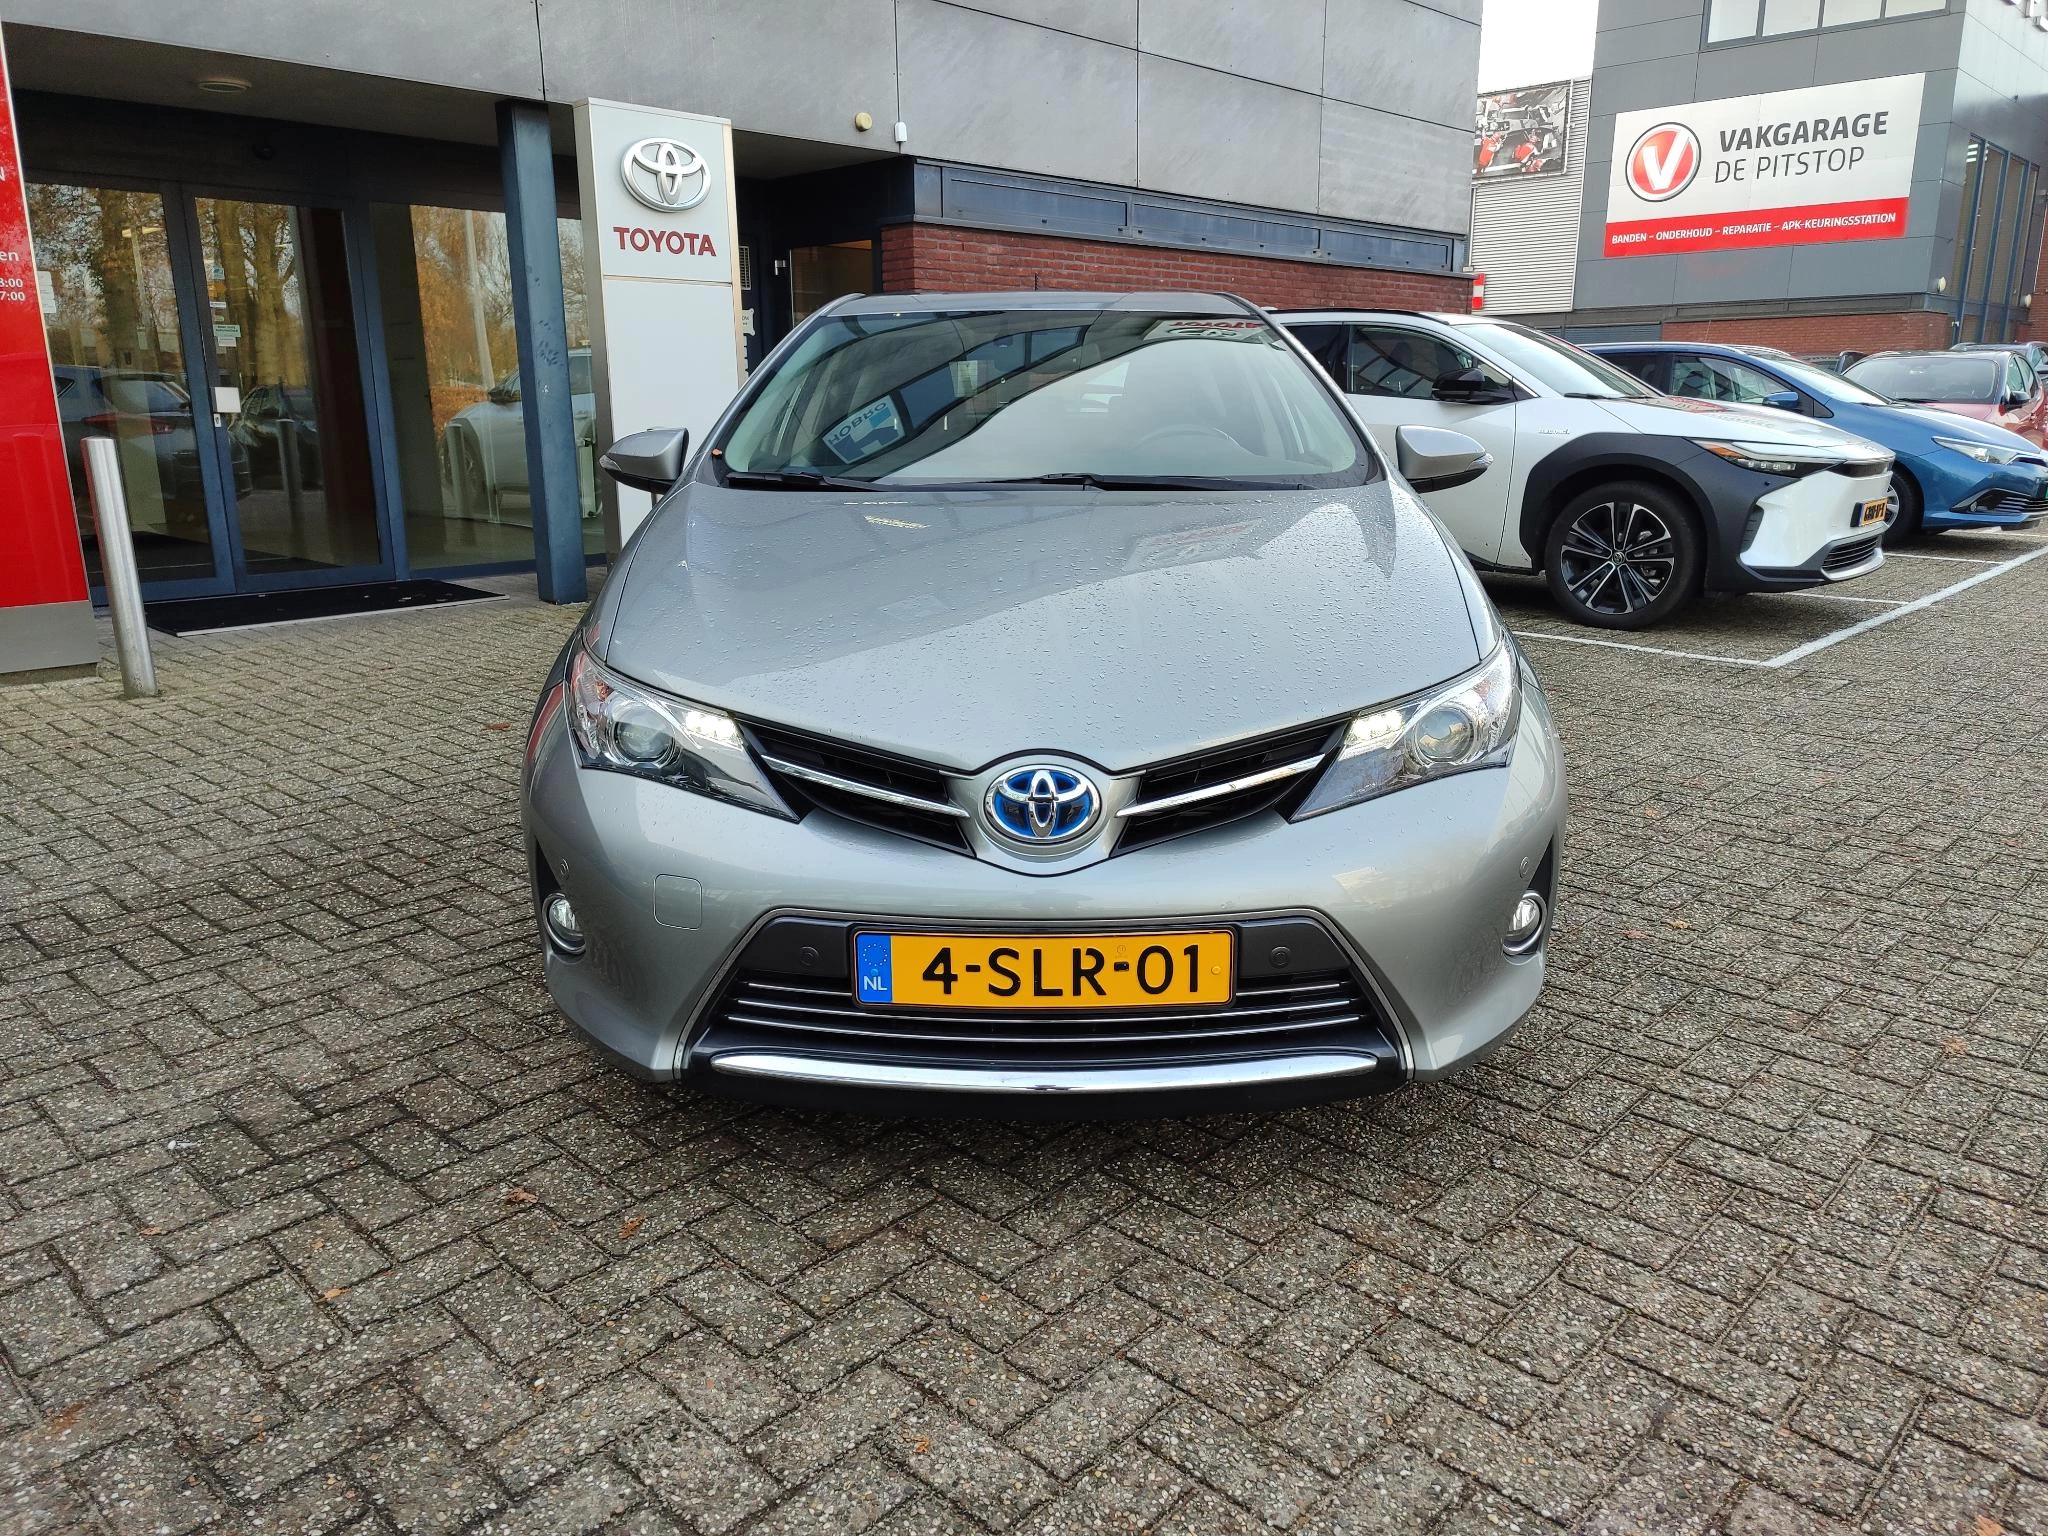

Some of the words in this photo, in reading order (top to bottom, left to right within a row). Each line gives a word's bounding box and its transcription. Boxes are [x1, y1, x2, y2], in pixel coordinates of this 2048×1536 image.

[1719, 111, 1889, 152] VAKGARAGE
[1714, 159, 1746, 183] DE
[1756, 146, 1865, 179] PITSTOP
[613, 227, 717, 257] TOYOTA
[1611, 233, 1648, 244] BANDEN
[1655, 227, 1713, 241] ONDERHOUD
[1722, 222, 1772, 236] REPARATIE
[1781, 212, 1897, 231] APK-KEURINGSSTATION
[864, 975, 888, 991] NL
[922, 944, 1199, 997] 4-SLR-01
